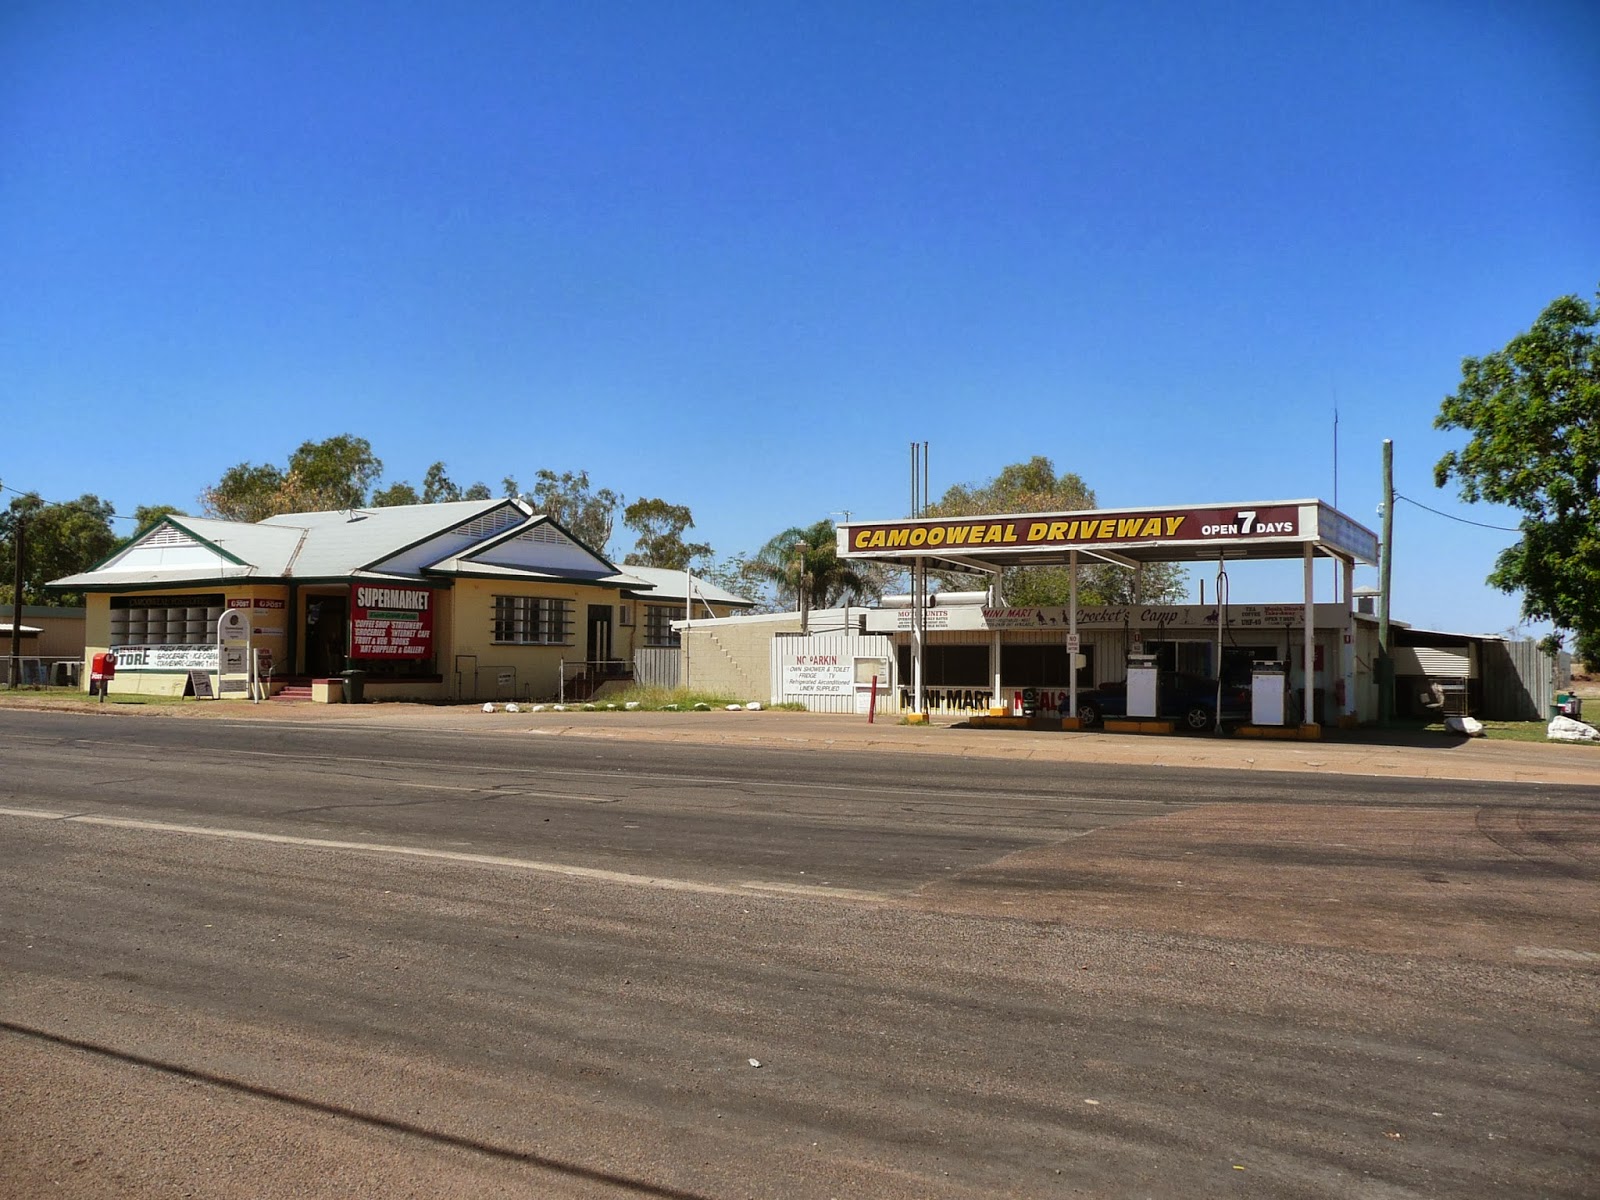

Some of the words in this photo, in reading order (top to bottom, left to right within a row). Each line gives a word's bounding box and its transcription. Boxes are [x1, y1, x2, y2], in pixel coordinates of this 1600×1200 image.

[1202, 524, 1238, 536] OPEN
[1237, 511, 1257, 534] 7
[1257, 522, 1293, 533] DAYS
[855, 524, 1018, 549] CAMOOWEAL
[1027, 516, 1185, 542] DRIVEWAY
[357, 587, 430, 610] SUPERMARKET
[981, 609, 1005, 618] MINI
[1007, 608, 1035, 618] MART
[1140, 608, 1178, 625] Camp
[355, 620, 375, 628] COFFEE
[375, 621, 390, 629] SHOP
[392, 621, 423, 630] STATIONERY
[355, 628, 386, 637] GROCERIES
[391, 629, 416, 638] INTERNET
[417, 630, 430, 638] CAFE
[377, 637, 388, 645] VEG
[391, 638, 410, 646] BOOKS
[360, 645, 371, 653] ART
[372, 645, 397, 654] SUPPLIES
[403, 646, 425, 654] GALLERY
[901, 689, 993, 710] MNI-MART
[1014, 691, 1067, 711] MALS
